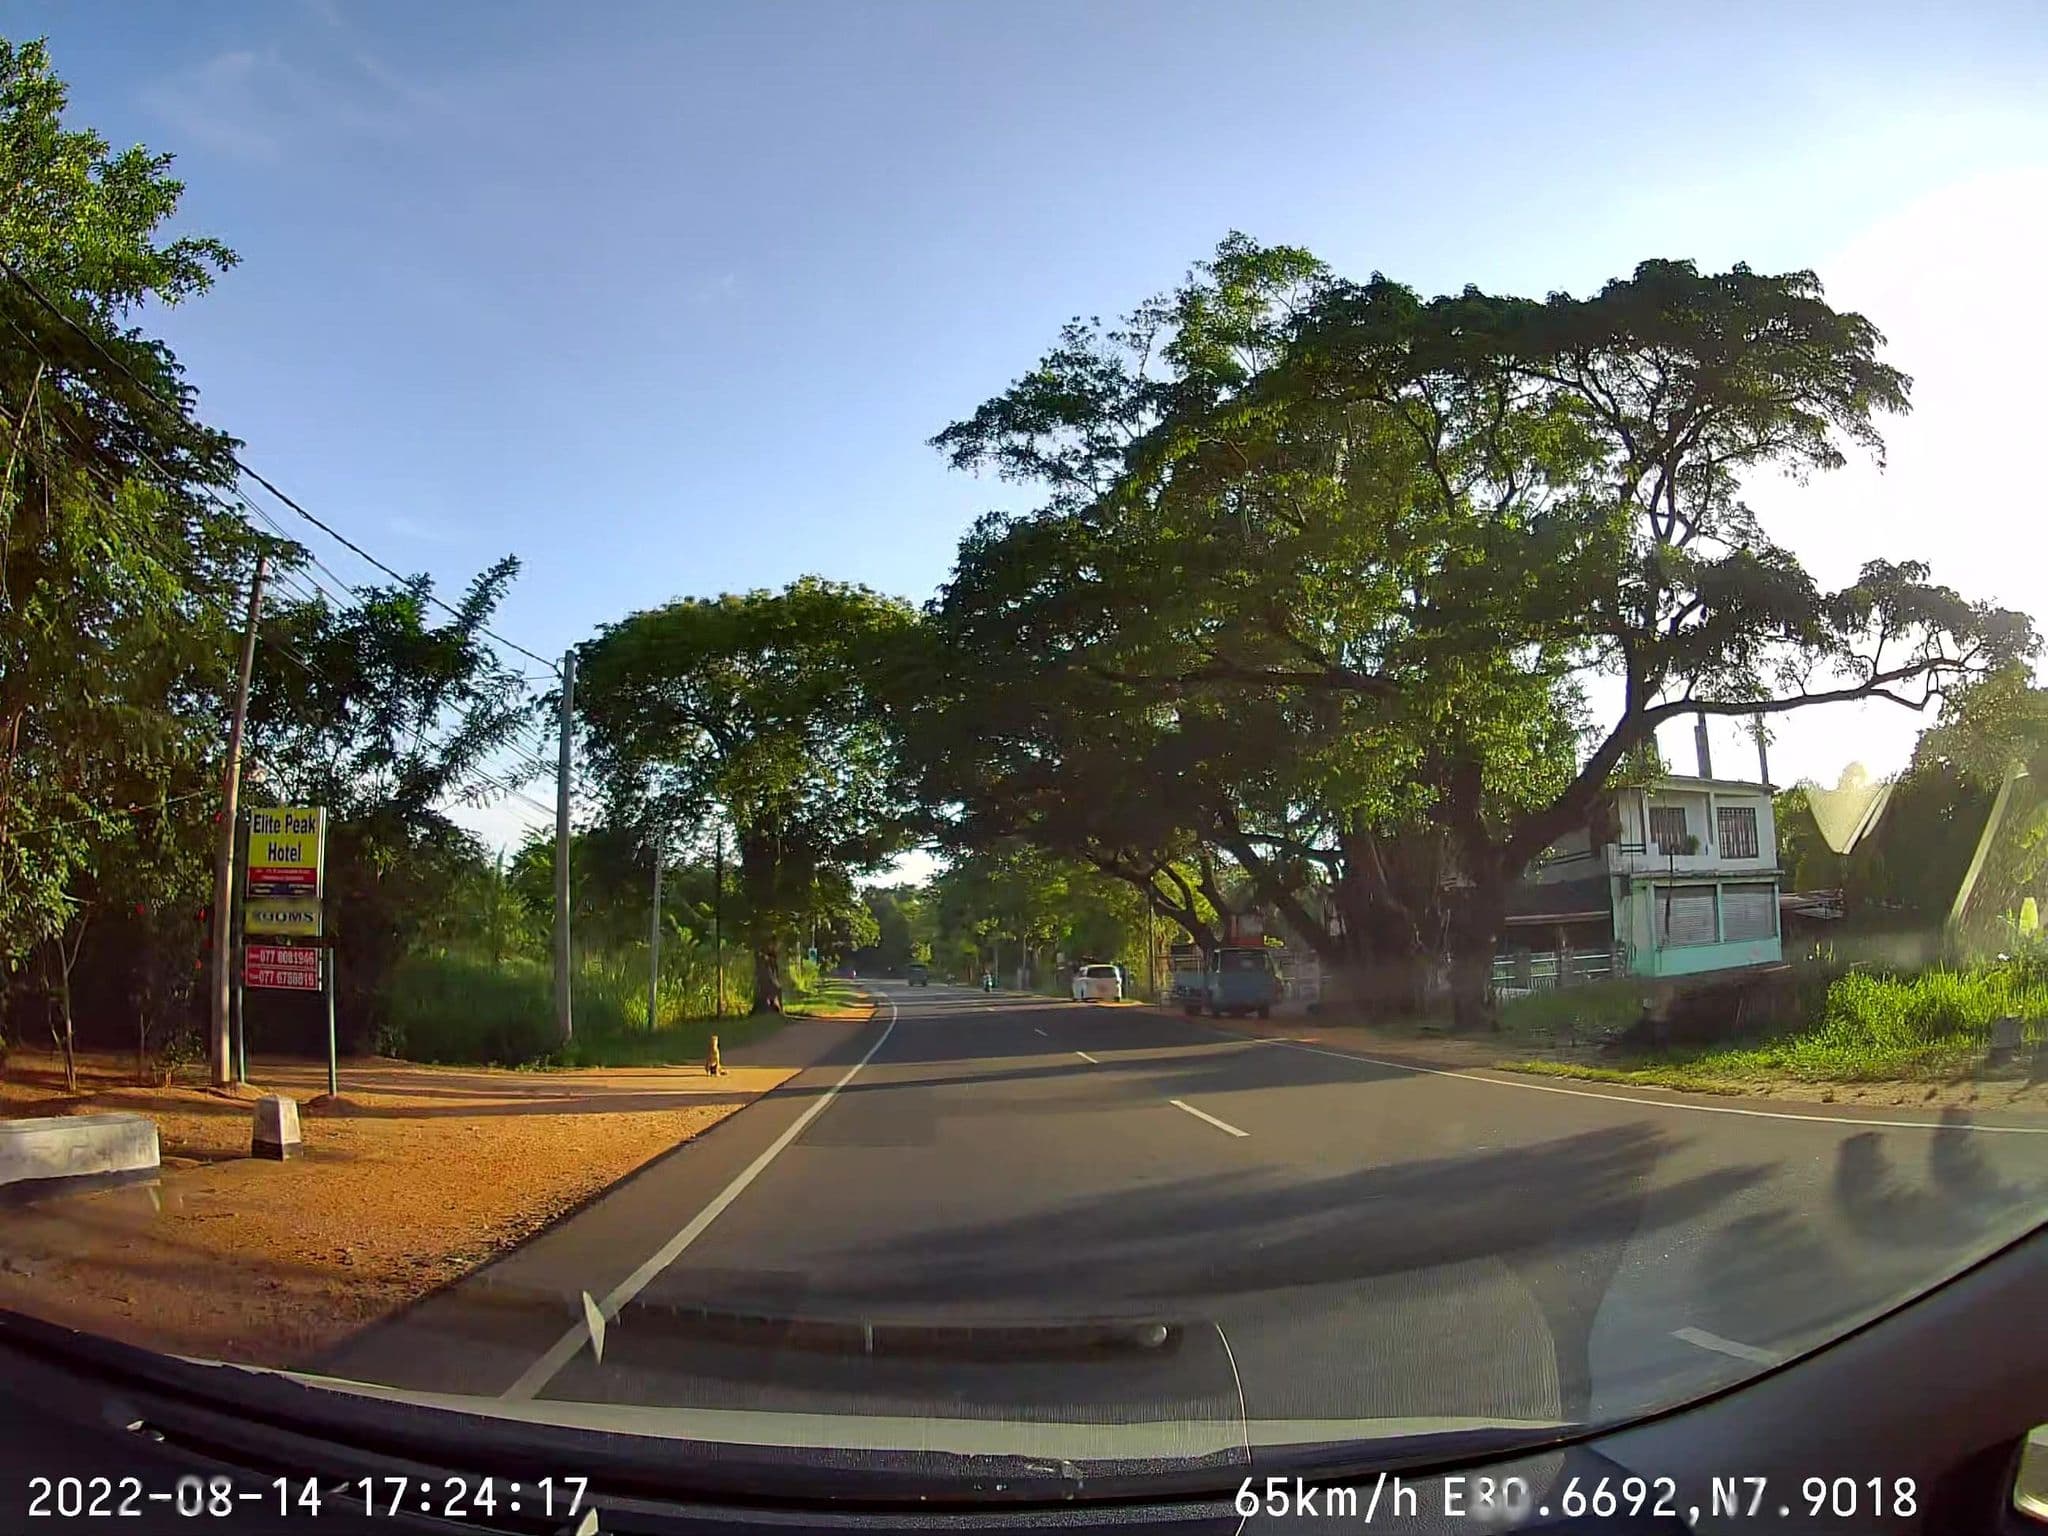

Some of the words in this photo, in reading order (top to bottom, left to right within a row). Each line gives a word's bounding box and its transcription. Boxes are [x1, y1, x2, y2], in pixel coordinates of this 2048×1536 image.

[253, 814, 281, 834] Elite
[285, 814, 316, 834] Peak
[268, 842, 302, 862] Hotel
